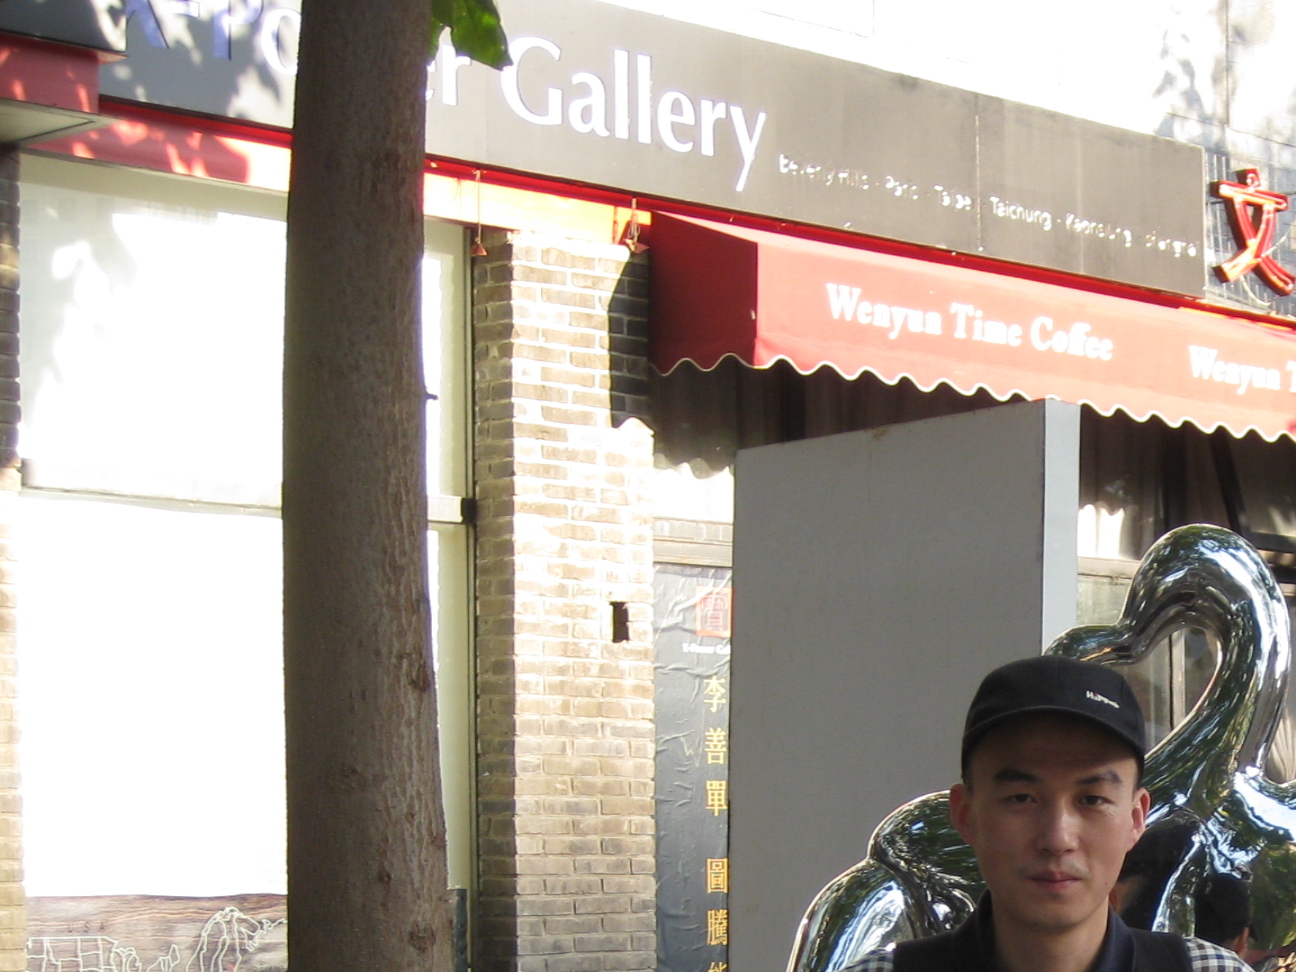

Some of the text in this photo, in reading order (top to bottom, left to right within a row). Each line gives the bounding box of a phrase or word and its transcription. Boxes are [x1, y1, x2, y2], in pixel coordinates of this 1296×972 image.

[499, 36, 767, 192] Gallery
[826, 283, 1114, 361] Wenyun Time Coffee
[1188, 345, 1280, 395] Wenyun
